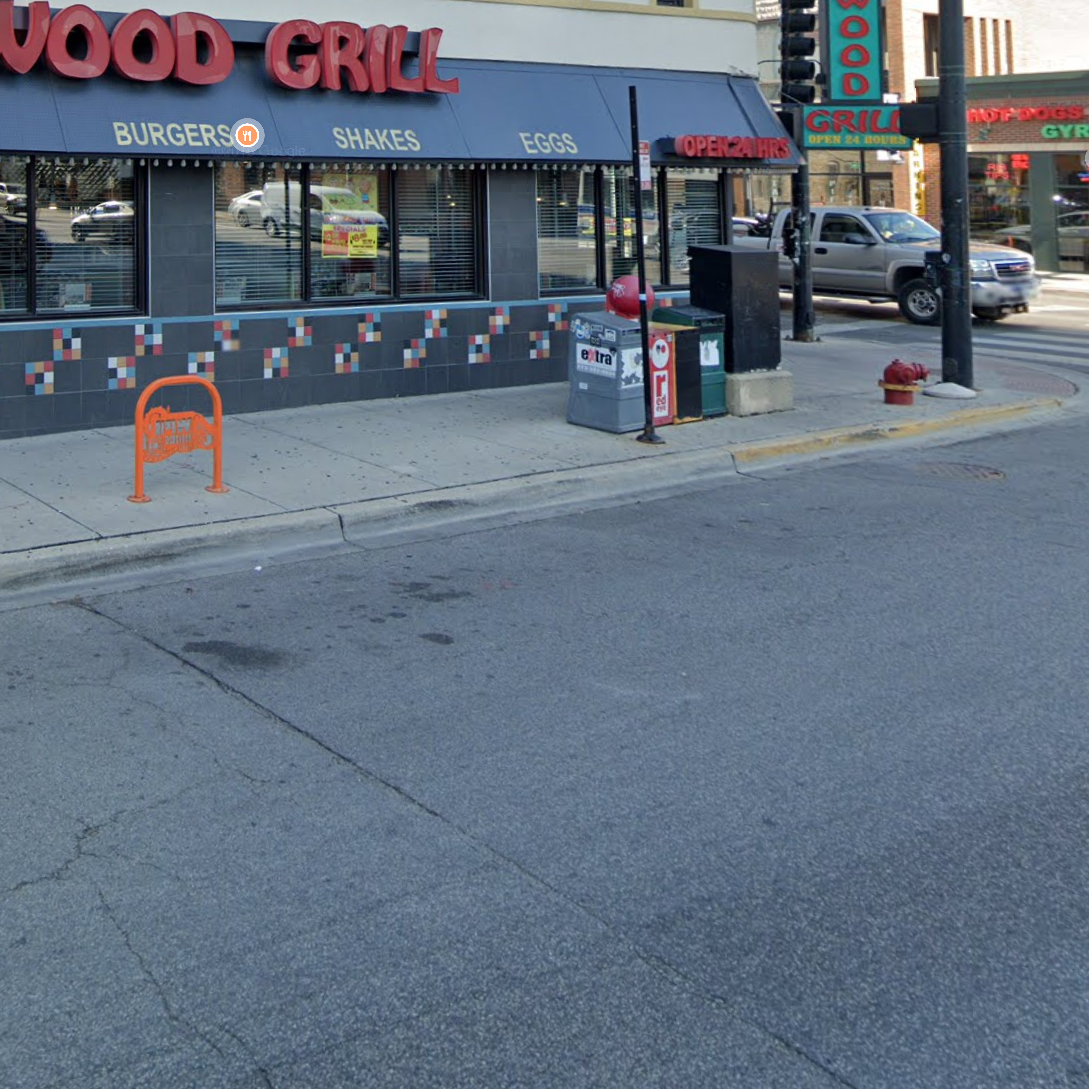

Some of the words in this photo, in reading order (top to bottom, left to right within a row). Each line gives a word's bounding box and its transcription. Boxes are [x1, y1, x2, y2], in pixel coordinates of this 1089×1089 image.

[265, 18, 460, 95] GRILL
[967, 106, 1015, 124] HOT
[1017, 104, 1086, 121] DOGS
[113, 122, 235, 147] BURGERS
[332, 127, 421, 151] SHAKES
[519, 132, 578, 154] EGGS
[808, 135, 842, 144] OPEN
[845, 135, 861, 144] 24
[864, 135, 907, 145] HOURS
[675, 135, 729, 157] OPEN
[730, 136, 753, 158] 24
[755, 137, 790, 159] HRS
[581, 348, 612, 365] extra
